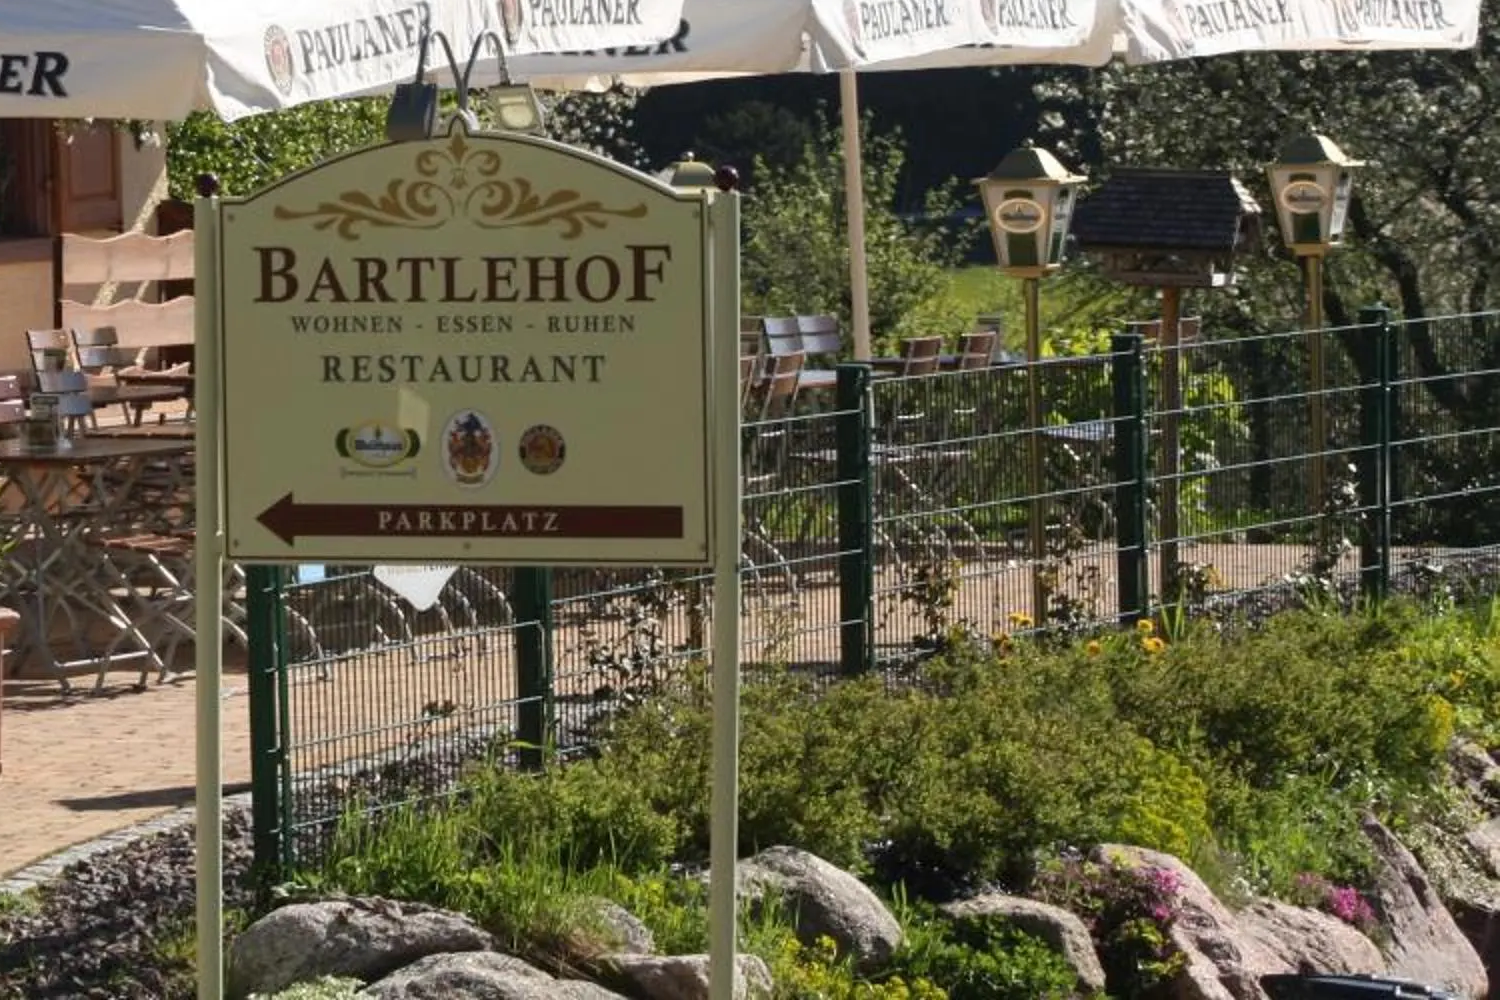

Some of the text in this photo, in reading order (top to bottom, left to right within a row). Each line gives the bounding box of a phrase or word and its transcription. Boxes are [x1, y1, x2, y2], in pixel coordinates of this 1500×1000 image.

[296, 0, 432, 75] PAULANER
[252, 244, 672, 304] BARTLEHOF
[291, 315, 403, 334] WOHNEN
[436, 314, 514, 334] ESSEN
[547, 314, 636, 334] RUHEN
[321, 354, 607, 384] RESTAURANT
[378, 510, 560, 532] PARKPLATZ
